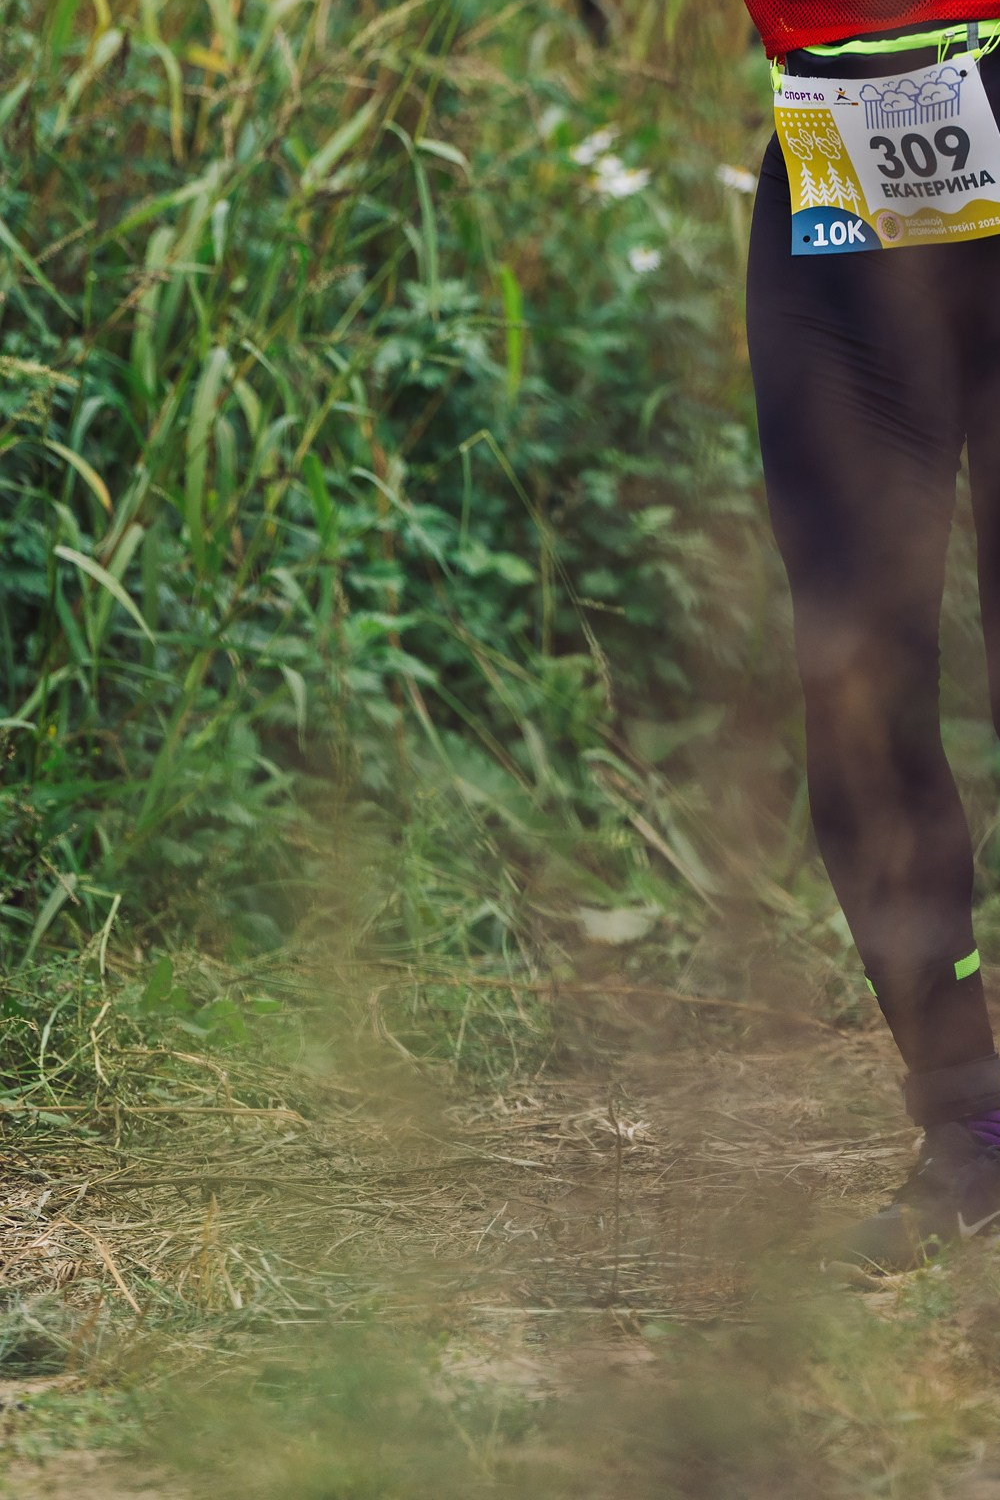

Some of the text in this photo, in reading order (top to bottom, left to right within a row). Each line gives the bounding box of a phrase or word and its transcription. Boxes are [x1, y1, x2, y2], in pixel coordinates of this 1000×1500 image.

[784, 90, 825, 102] СПОРТ 40
[869, 125, 971, 179] 309
[880, 169, 996, 198] ЕКАТЕРИНА
[813, 219, 866, 247] 10K
[949, 221, 976, 234] ТРЕЙЛ
[977, 216, 1000, 229] 2025
